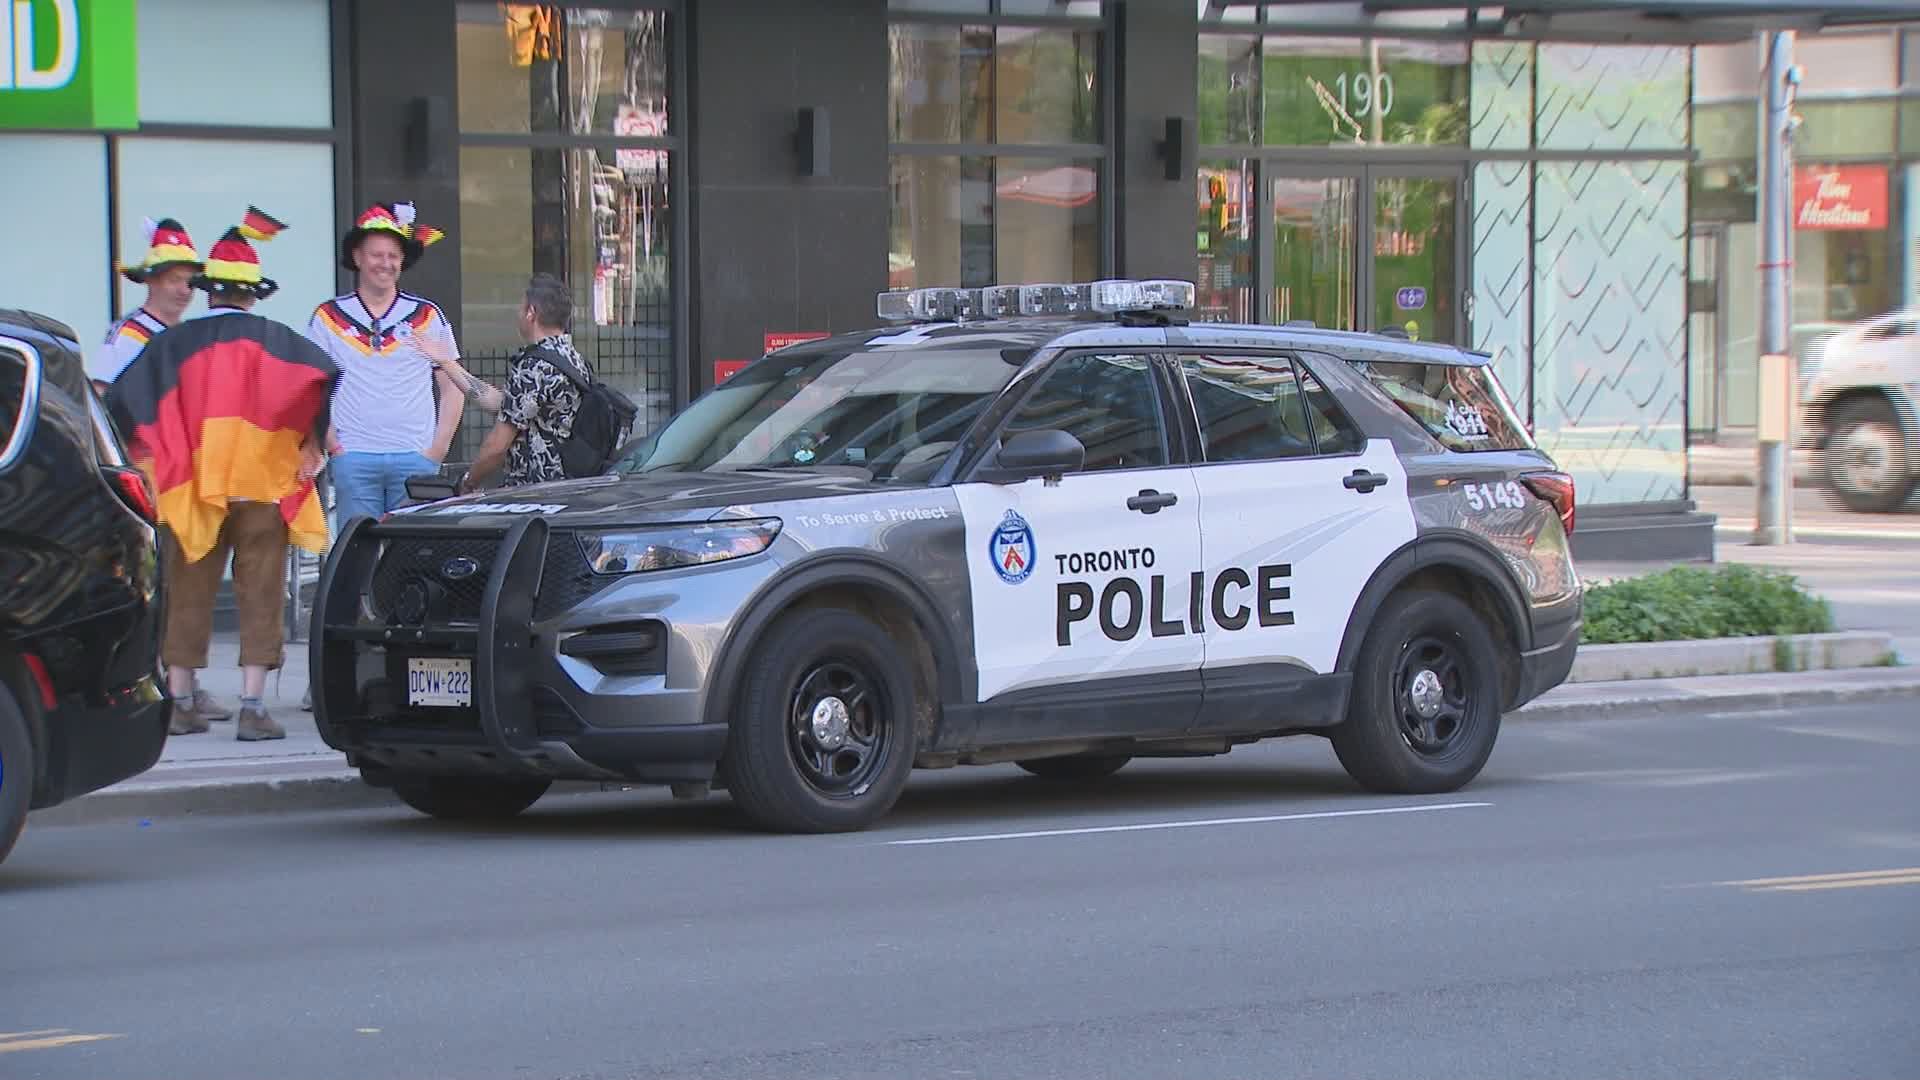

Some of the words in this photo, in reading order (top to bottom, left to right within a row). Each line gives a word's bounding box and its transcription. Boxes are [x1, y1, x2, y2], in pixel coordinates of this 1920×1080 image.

[0, 0, 79, 90] D
[1336, 71, 1393, 117] 190
[1463, 481, 1526, 511] 5143
[796, 515, 820, 528] To
[822, 512, 870, 526] Serve
[872, 510, 887, 522] &
[888, 505, 948, 521] Protect
[1055, 547, 1155, 575] TORONTO
[1056, 563, 1295, 647] POLICE
